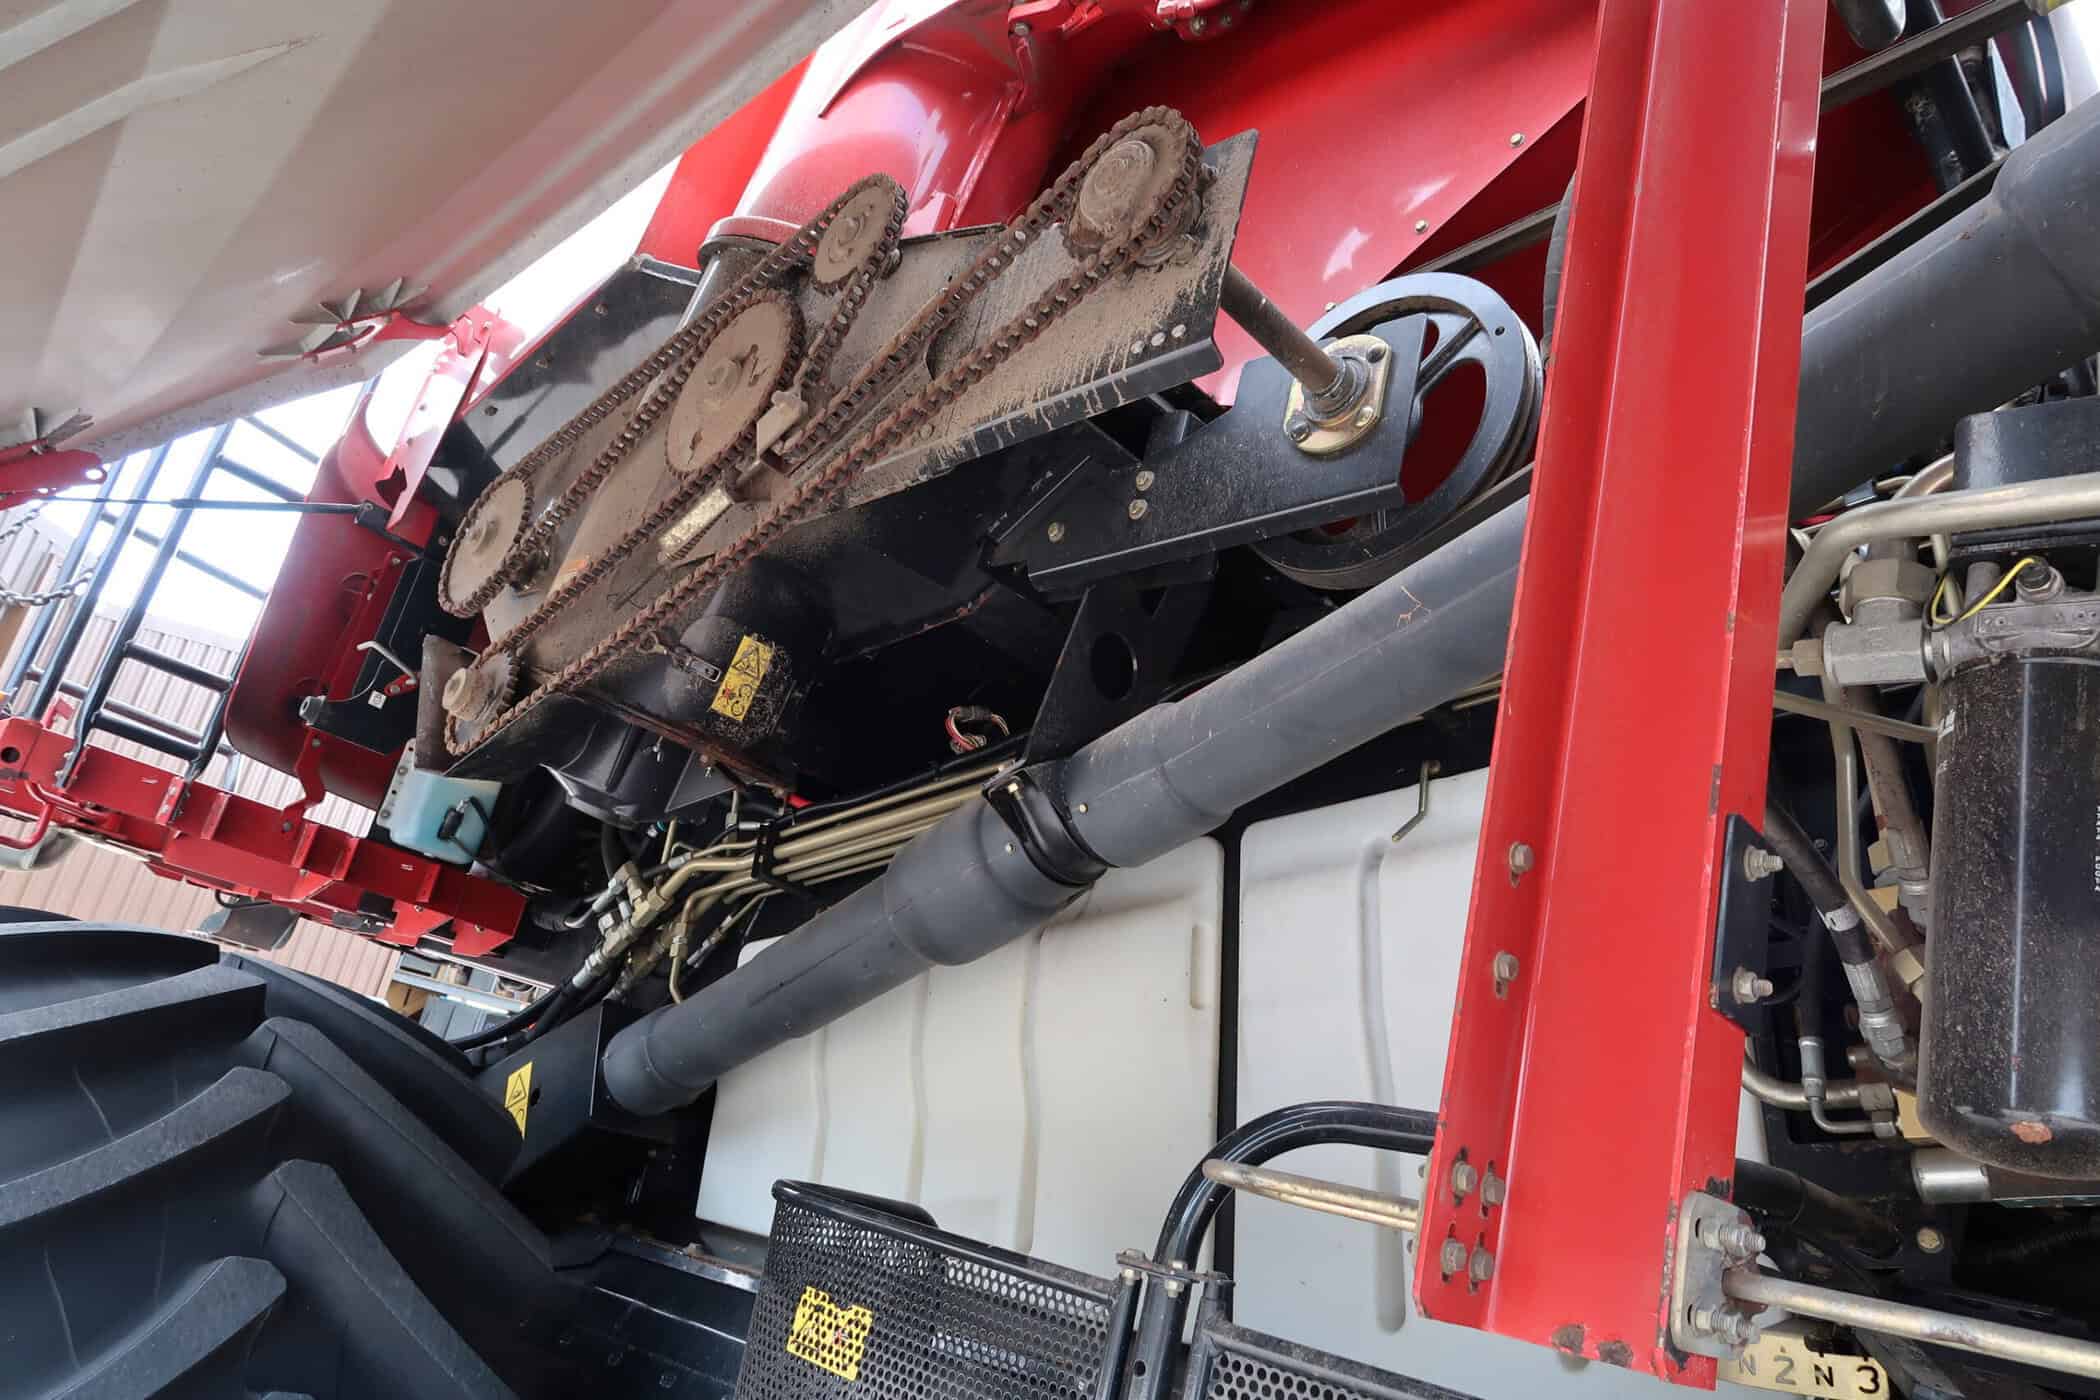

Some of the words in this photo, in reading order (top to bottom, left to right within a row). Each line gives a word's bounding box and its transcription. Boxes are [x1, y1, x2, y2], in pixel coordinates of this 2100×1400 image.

[1739, 1355, 1757, 1377] N
[1774, 1355, 1796, 1386] 2
[1814, 1363, 1834, 1388] N
[1856, 1365, 1880, 1394] 3
